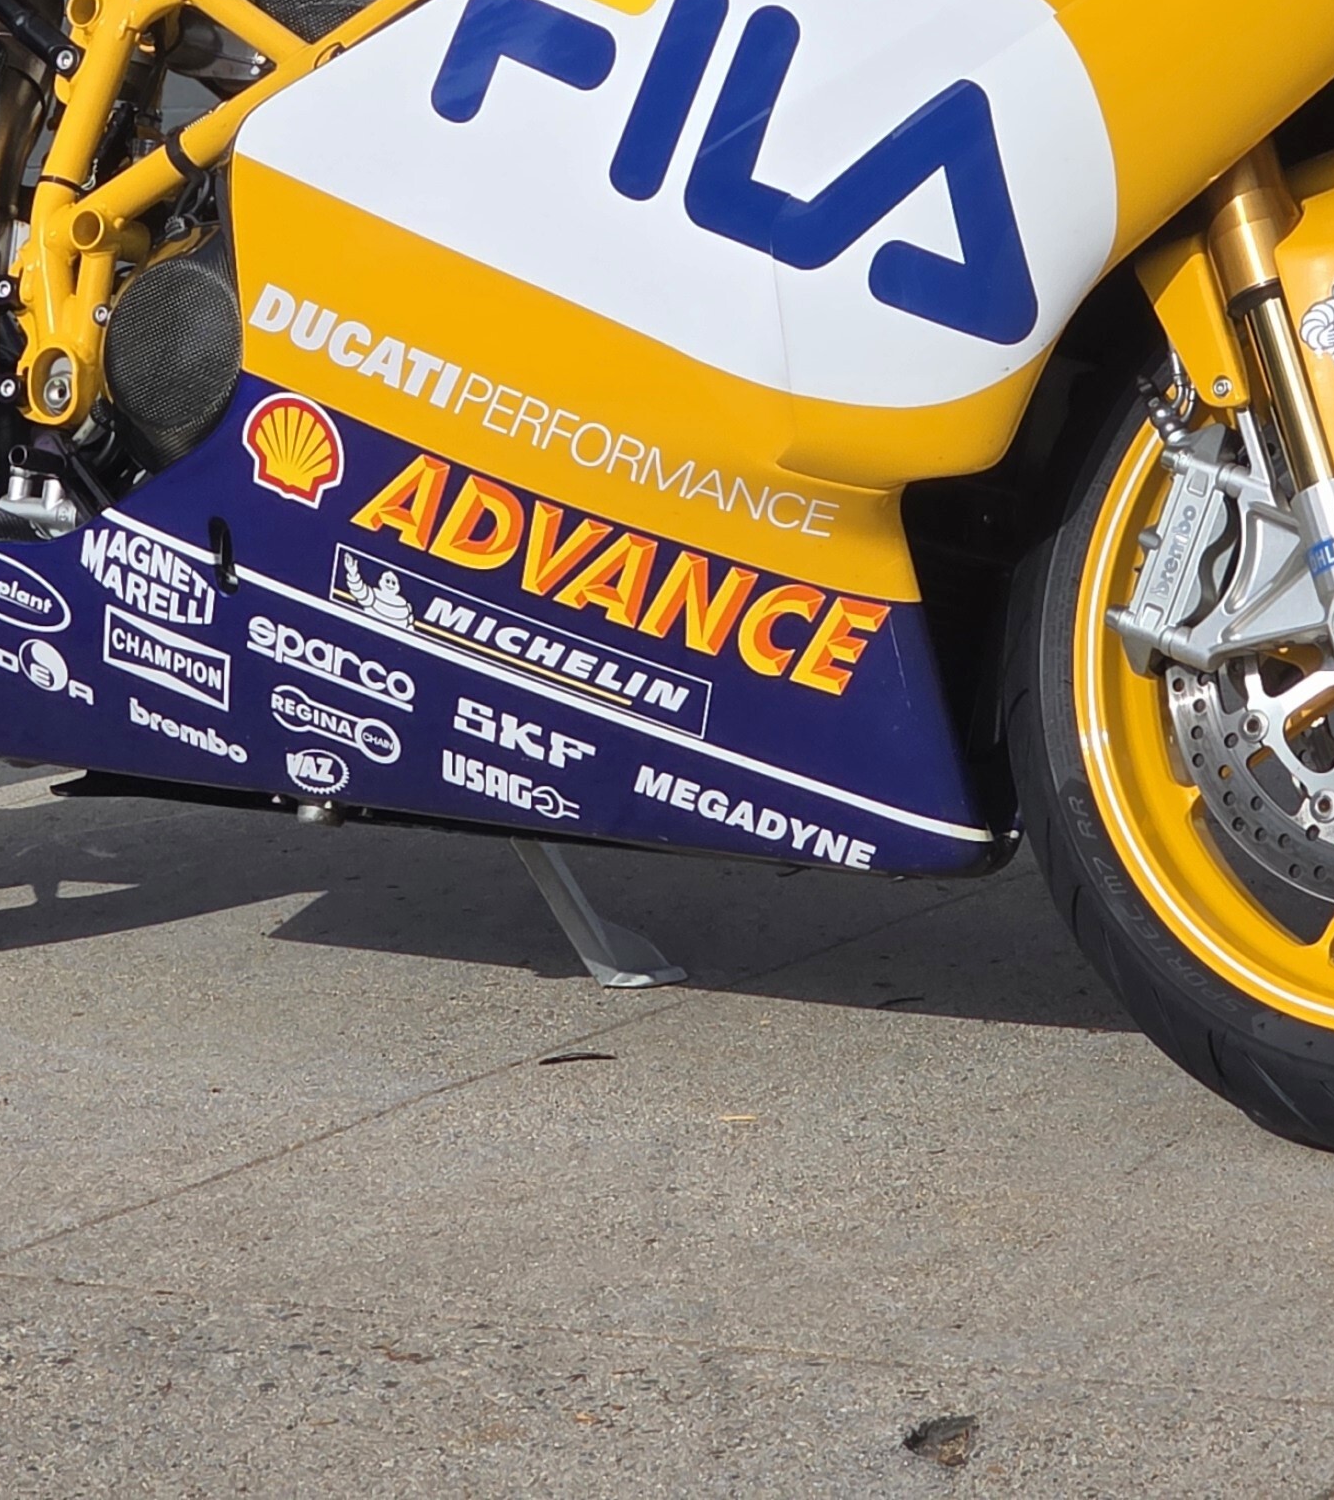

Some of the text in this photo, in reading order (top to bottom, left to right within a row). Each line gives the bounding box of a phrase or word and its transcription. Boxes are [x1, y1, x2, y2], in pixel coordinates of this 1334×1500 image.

[248, 283, 840, 539] DUCATI PERFORMANCE
[80, 528, 215, 599] MAGNETI
[80, 556, 215, 625] MARELLI
[350, 453, 891, 696] ADVANCE
[111, 627, 222, 690] CHAMPION
[248, 615, 415, 704] sparco
[423, 596, 691, 713] MICHELIN
[129, 697, 248, 764] brembo
[270, 692, 354, 739] REGINA
[362, 731, 395, 752] CHAIN
[453, 697, 596, 769] SKF
[442, 749, 533, 809] USAG
[633, 765, 877, 870] MEGADYNE
[1068, 794, 1099, 842] RR
[1126, 905, 1250, 1014] SPORTEC
